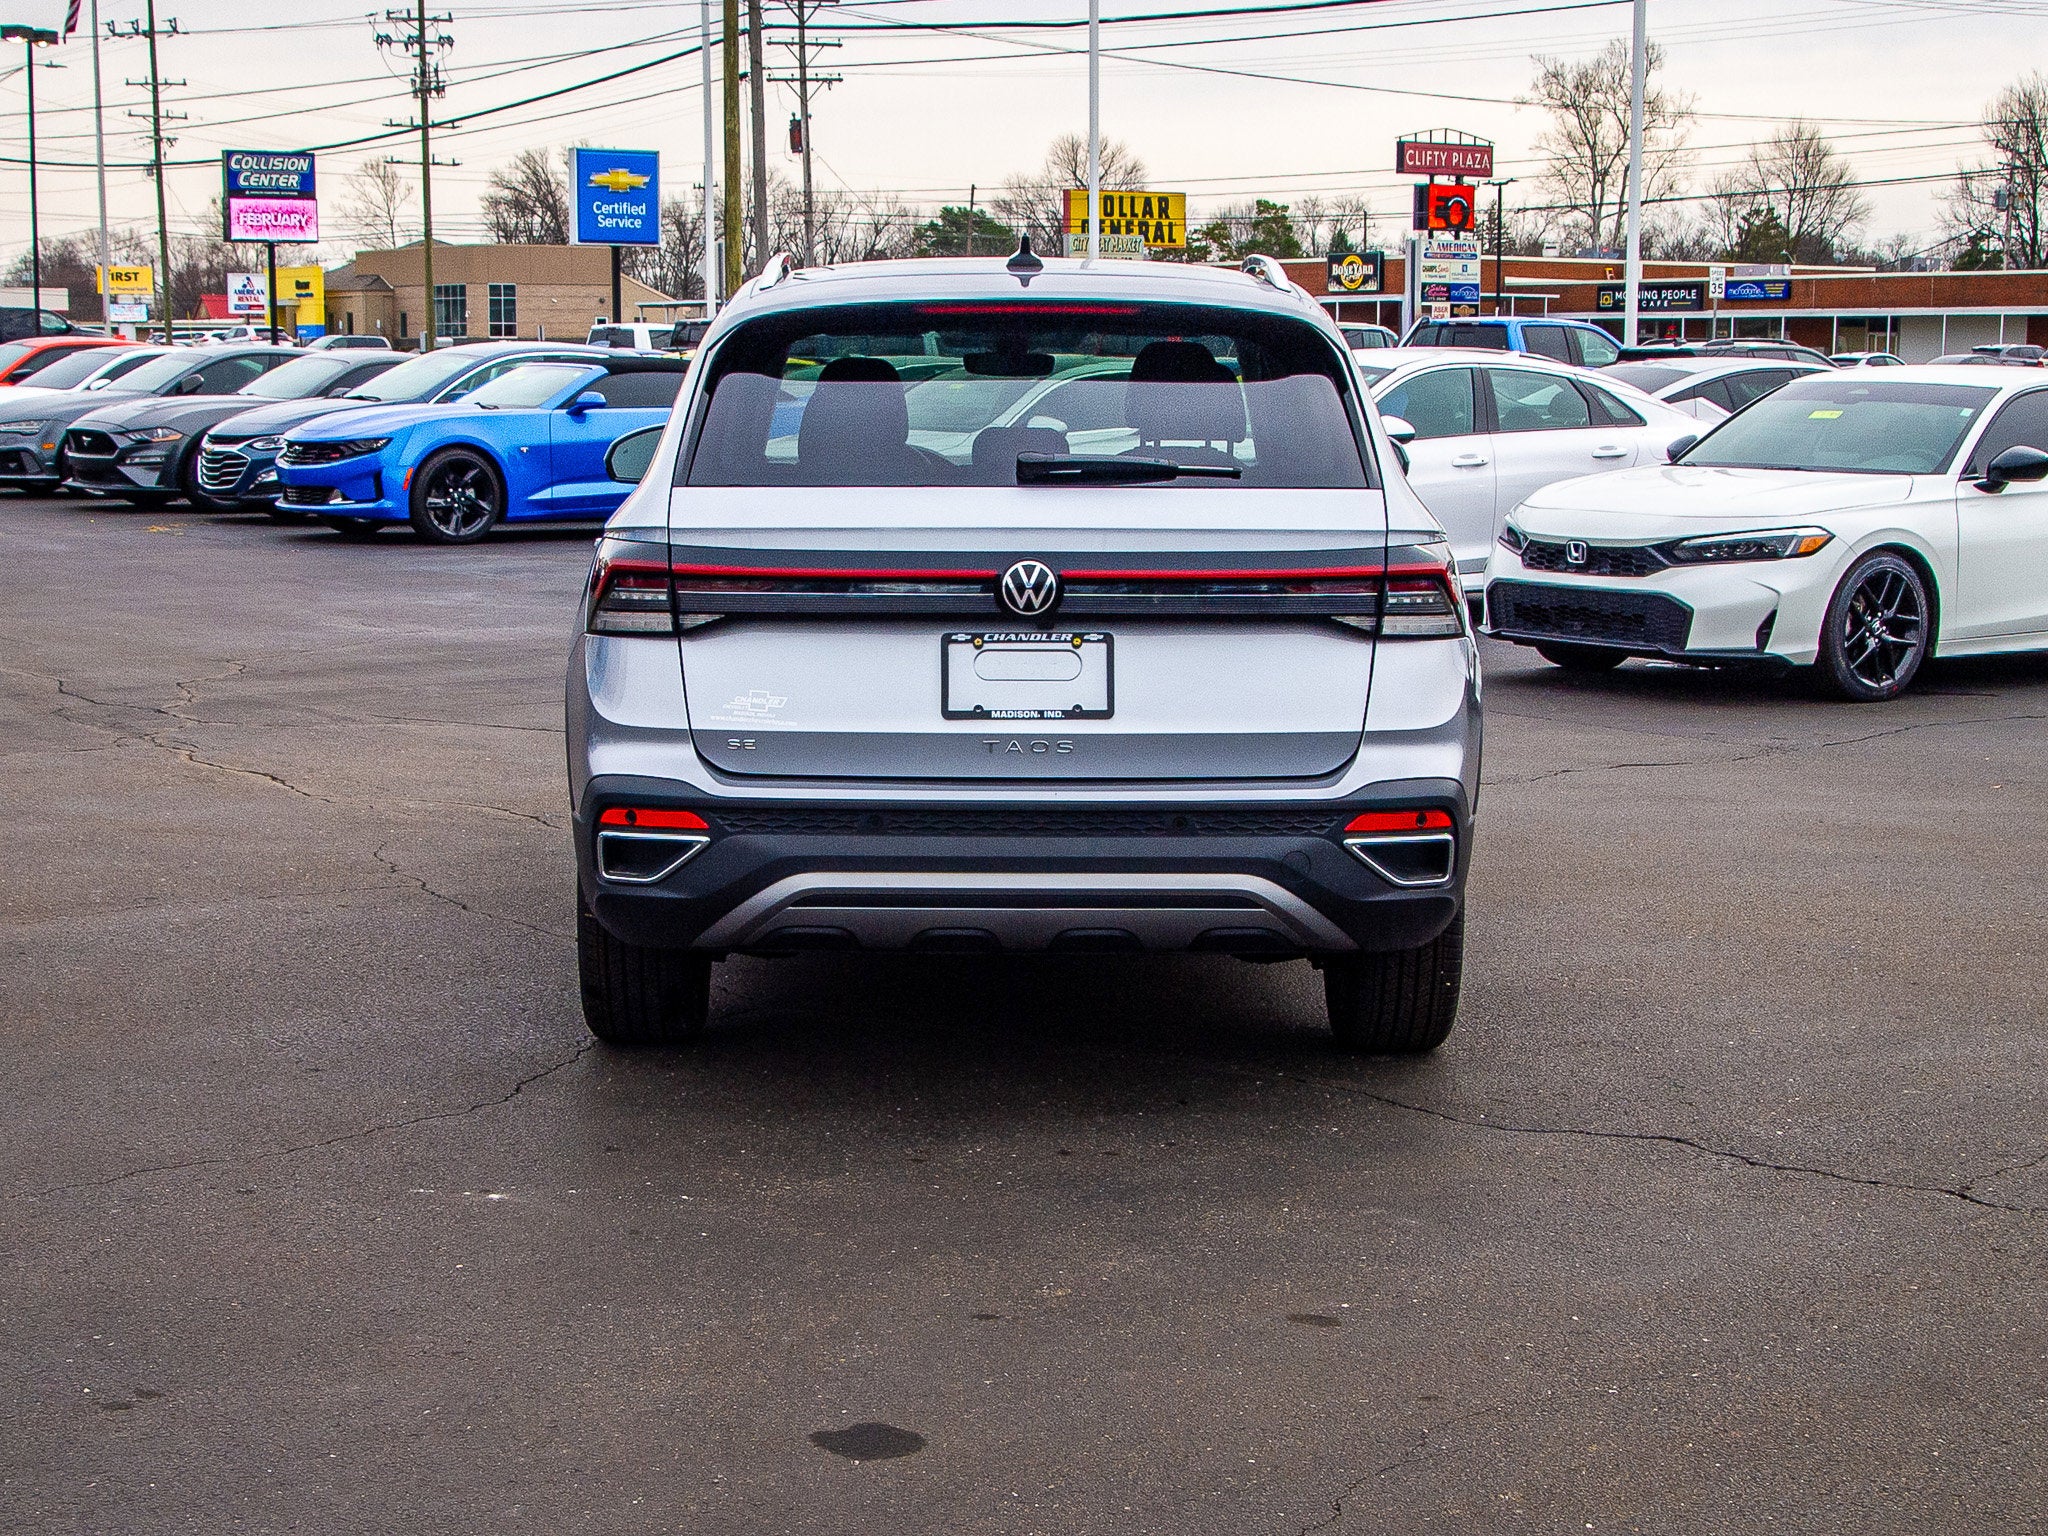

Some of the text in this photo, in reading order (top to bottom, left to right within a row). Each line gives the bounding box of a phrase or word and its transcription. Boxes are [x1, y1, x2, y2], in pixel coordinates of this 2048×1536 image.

[230, 154, 309, 171] COLLISION
[1405, 149, 1490, 169] CLIFTY PLAZA
[239, 171, 299, 187] CENTER
[593, 201, 646, 215] Certified
[1087, 194, 1170, 219] OLLAR
[240, 212, 308, 226] FEBRUARY
[597, 214, 642, 228] Service
[1111, 236, 1142, 253] MARKET
[1436, 242, 1478, 252] AMERICAN
[110, 271, 139, 281] IRST
[1615, 289, 1697, 300] MOING PEOPLE
[1711, 282, 1724, 294] 35
[983, 633, 1073, 641] CHANDLER
[727, 738, 756, 750] SE
[982, 740, 1073, 753] TAOS
